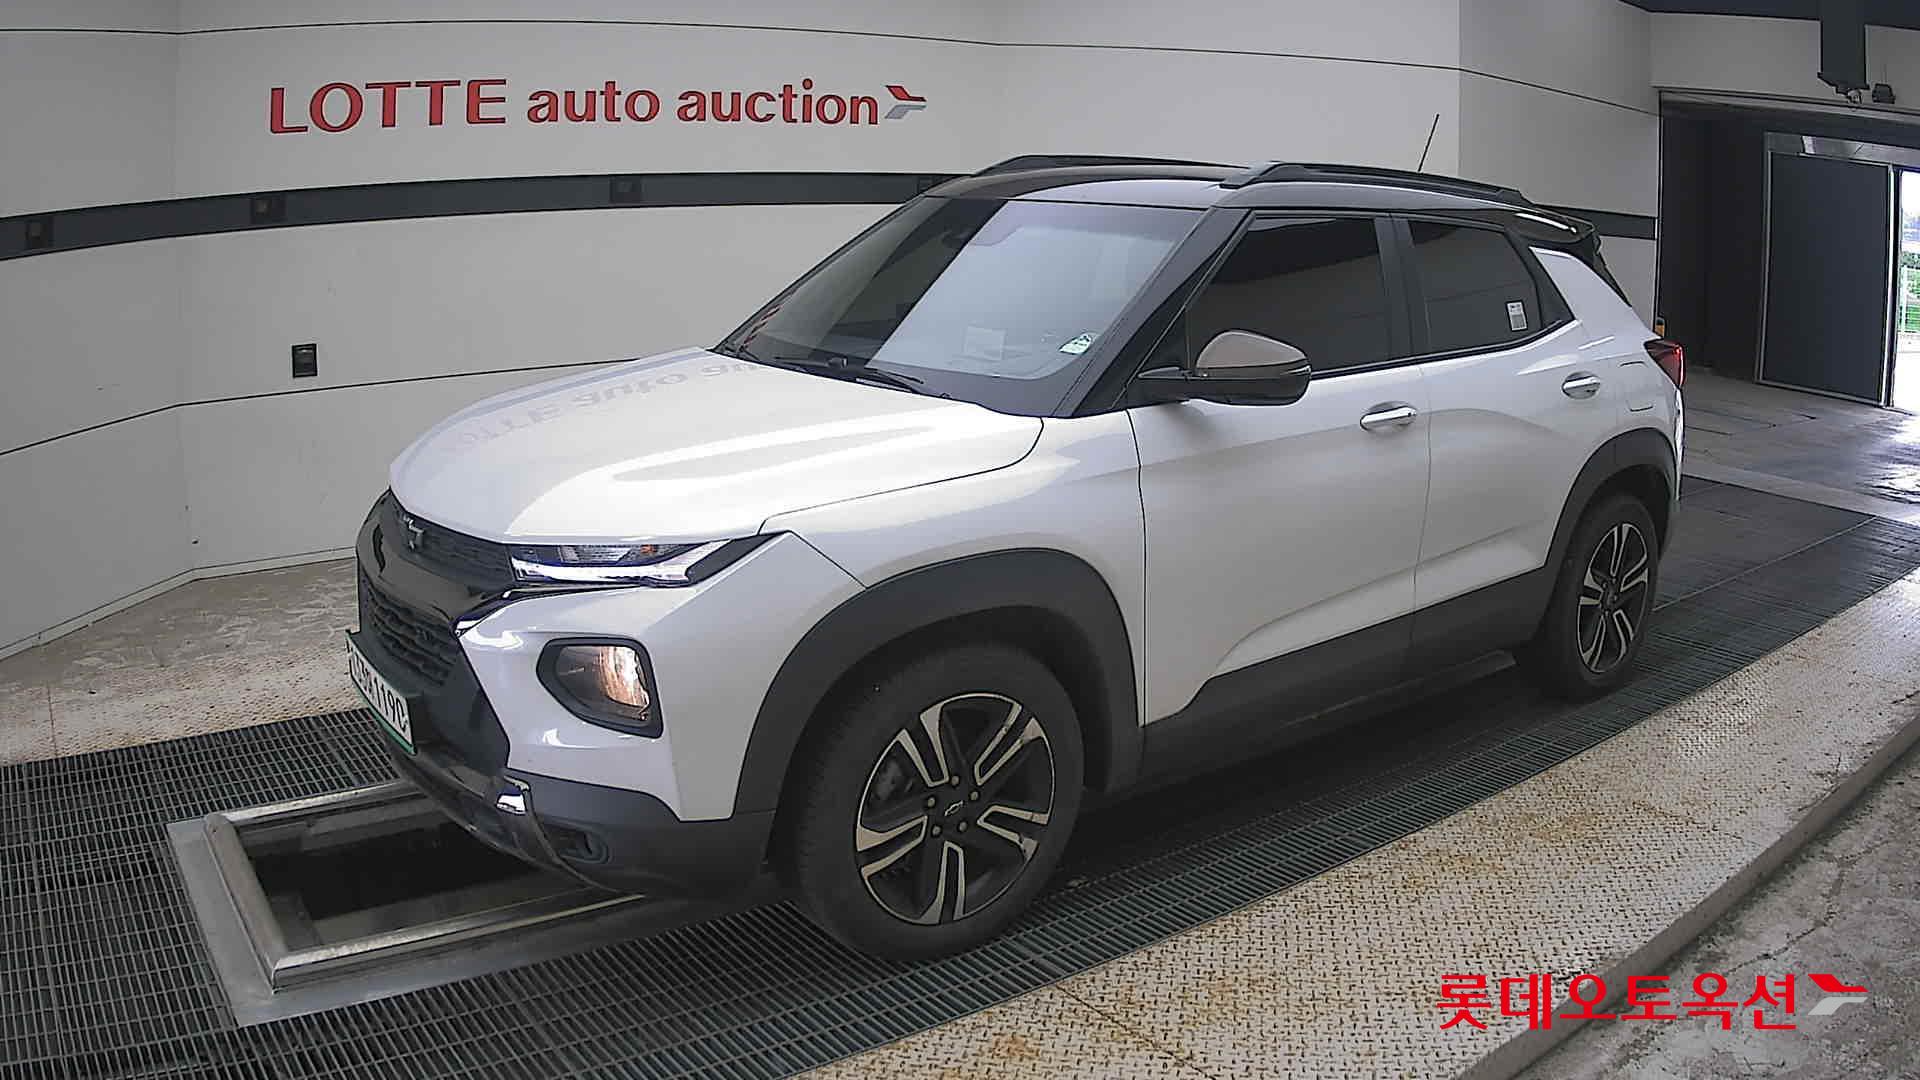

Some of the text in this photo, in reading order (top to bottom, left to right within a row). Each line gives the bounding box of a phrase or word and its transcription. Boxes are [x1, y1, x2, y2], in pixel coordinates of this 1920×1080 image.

[270, 78, 878, 134] LOTTE auto auction
